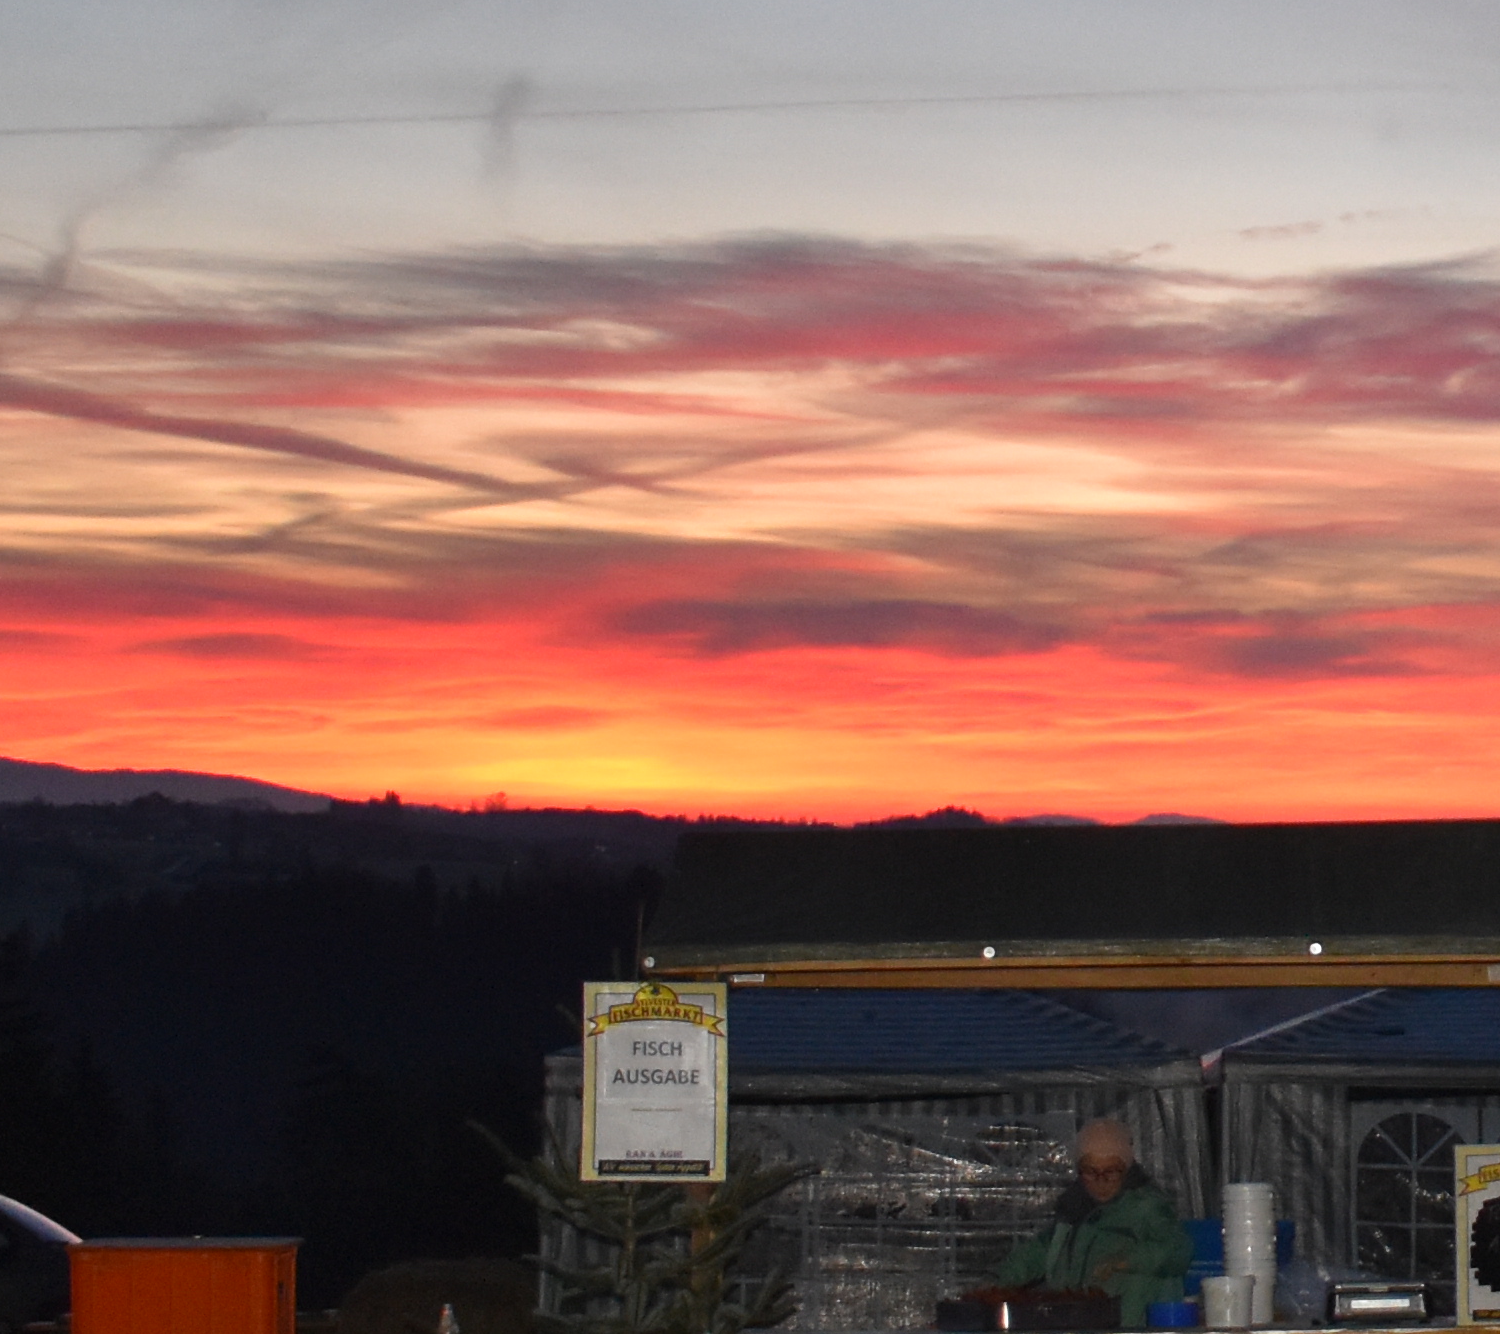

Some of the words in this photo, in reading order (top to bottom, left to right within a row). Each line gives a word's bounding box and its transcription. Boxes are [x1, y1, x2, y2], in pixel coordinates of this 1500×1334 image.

[611, 1006, 701, 1023] FISCHMARKT
[632, 1040, 684, 1057] FISCH
[612, 1068, 700, 1085] AUSGABE
